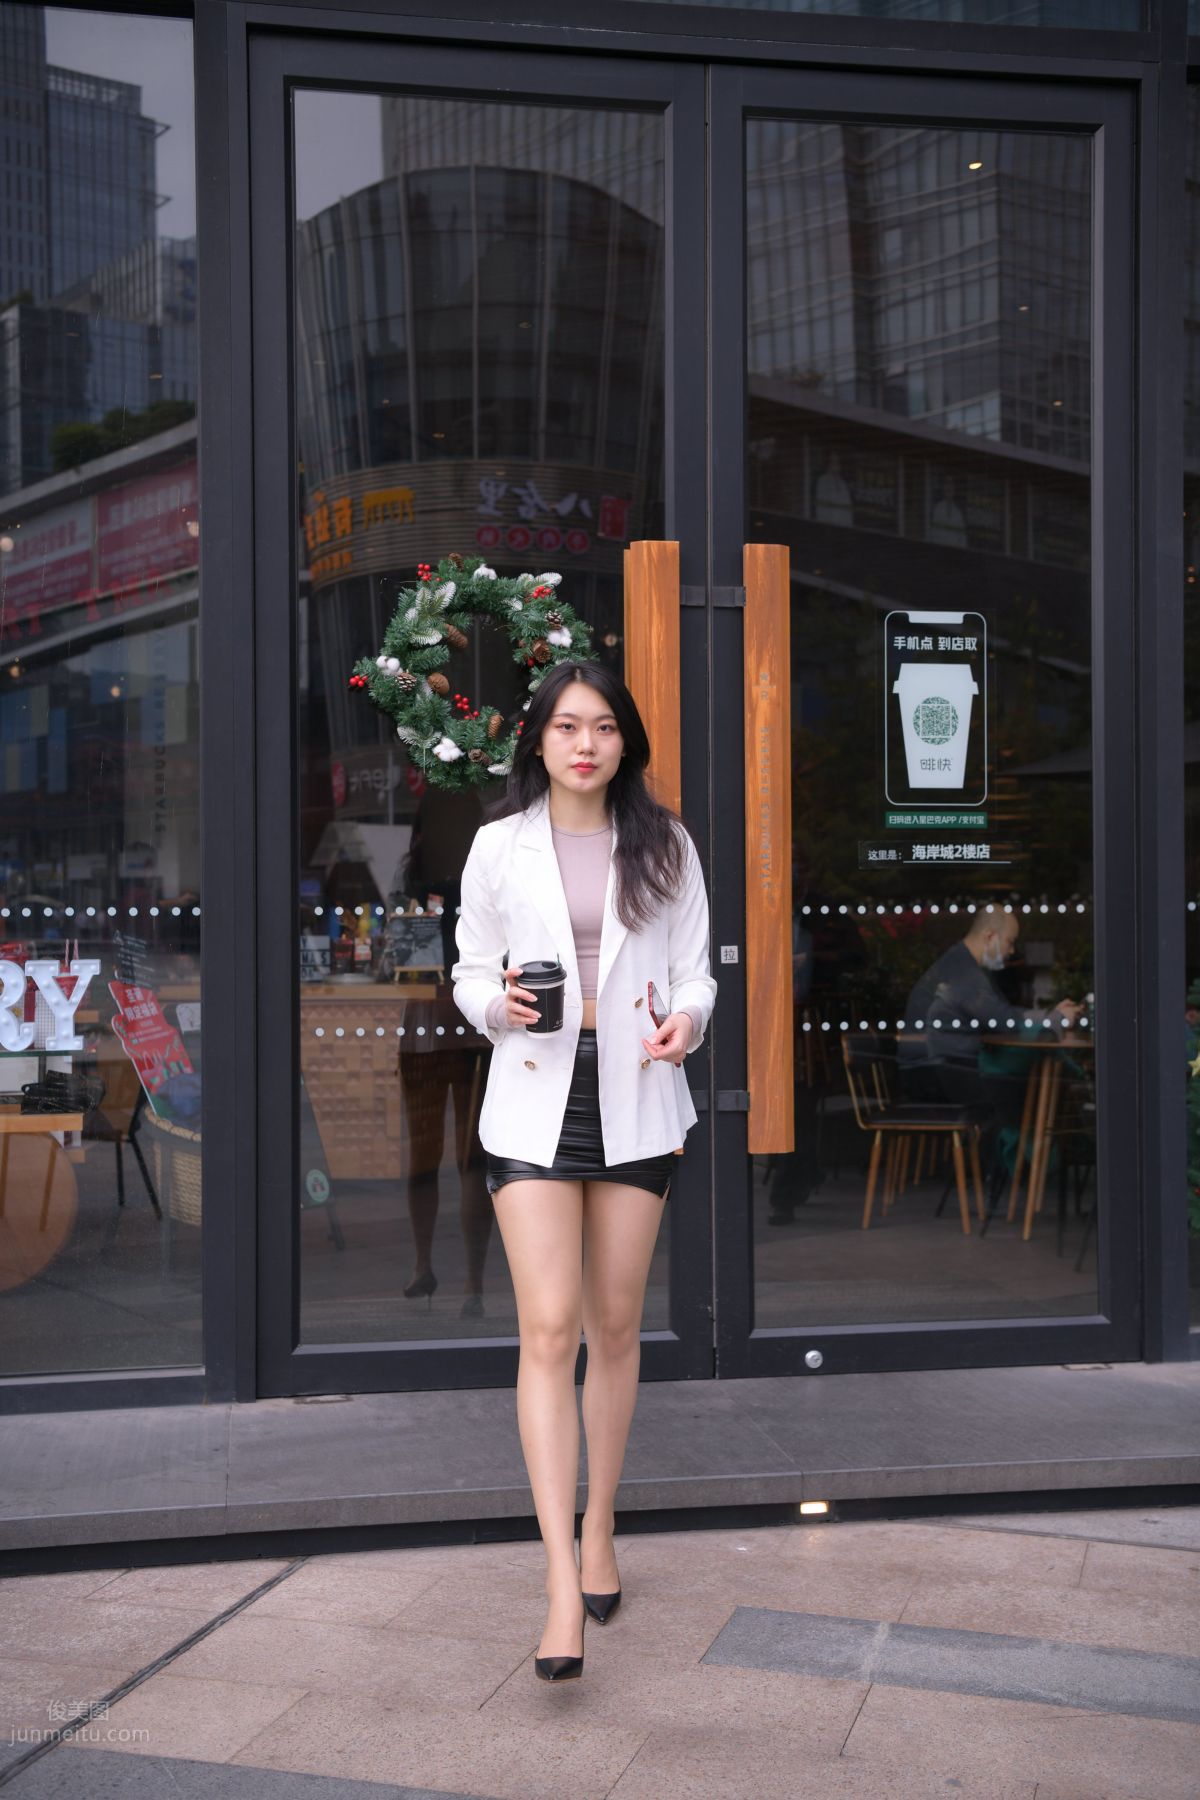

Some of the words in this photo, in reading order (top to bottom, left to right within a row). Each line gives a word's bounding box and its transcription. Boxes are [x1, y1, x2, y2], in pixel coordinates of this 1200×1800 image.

[893, 636, 933, 650] 手机点
[938, 636, 978, 651] 到店取
[912, 844, 991, 860] 海岸城2楼店
[723, 947, 736, 961] 拉
